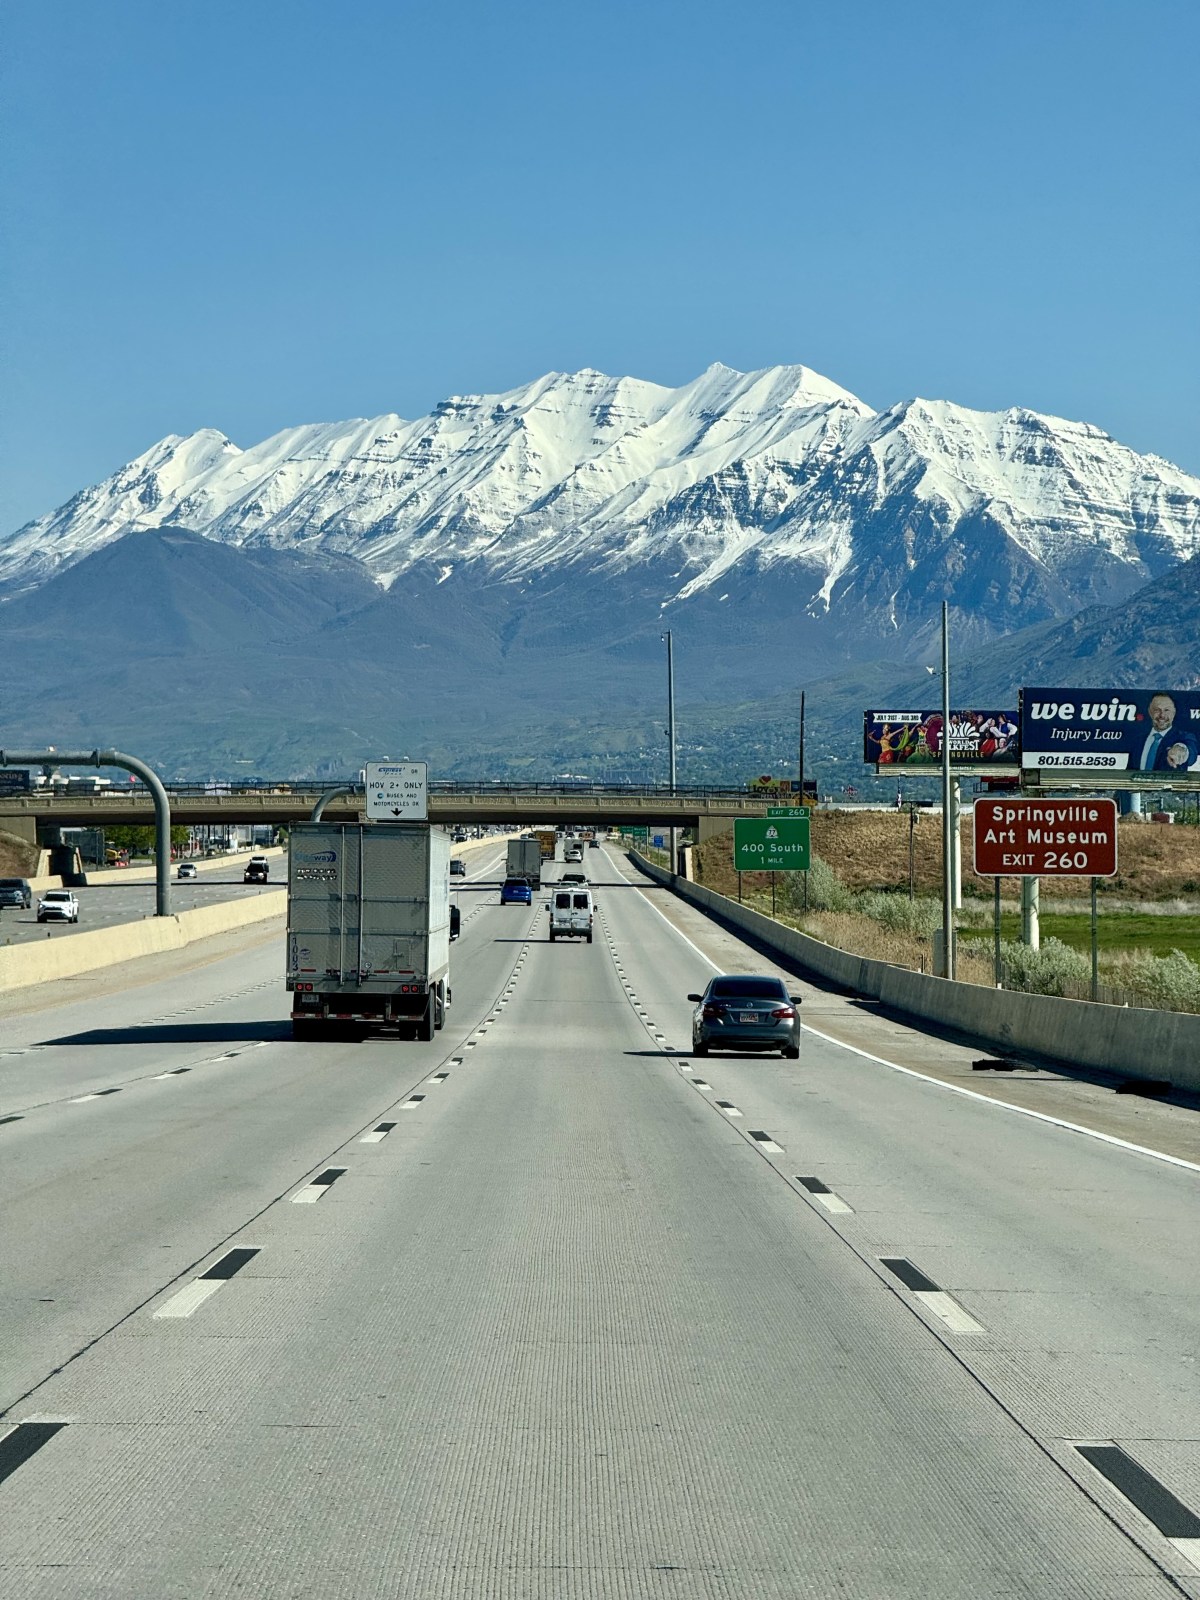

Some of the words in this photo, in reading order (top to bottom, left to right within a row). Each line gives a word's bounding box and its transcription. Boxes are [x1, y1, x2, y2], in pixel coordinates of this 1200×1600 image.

[1030, 702, 1075, 720] we
[1080, 697, 1144, 722] win.
[1050, 727, 1091, 742] Injury
[1094, 728, 1123, 740] Law
[938, 739, 980, 751] FLKFEST
[1037, 755, 1116, 767] 801.515.2539
[369, 781, 385, 789] HOV
[389, 781, 399, 789] 2+
[404, 781, 423, 789] ONLY
[788, 808, 805, 816] 260
[992, 805, 1100, 826] Springville
[984, 828, 1016, 845] Art
[1027, 828, 1108, 845] Museum
[741, 843, 765, 852] 400
[770, 843, 804, 852] South
[760, 856, 765, 864] 1
[1002, 853, 1036, 866] EXIT
[1043, 852, 1088, 869] 260
